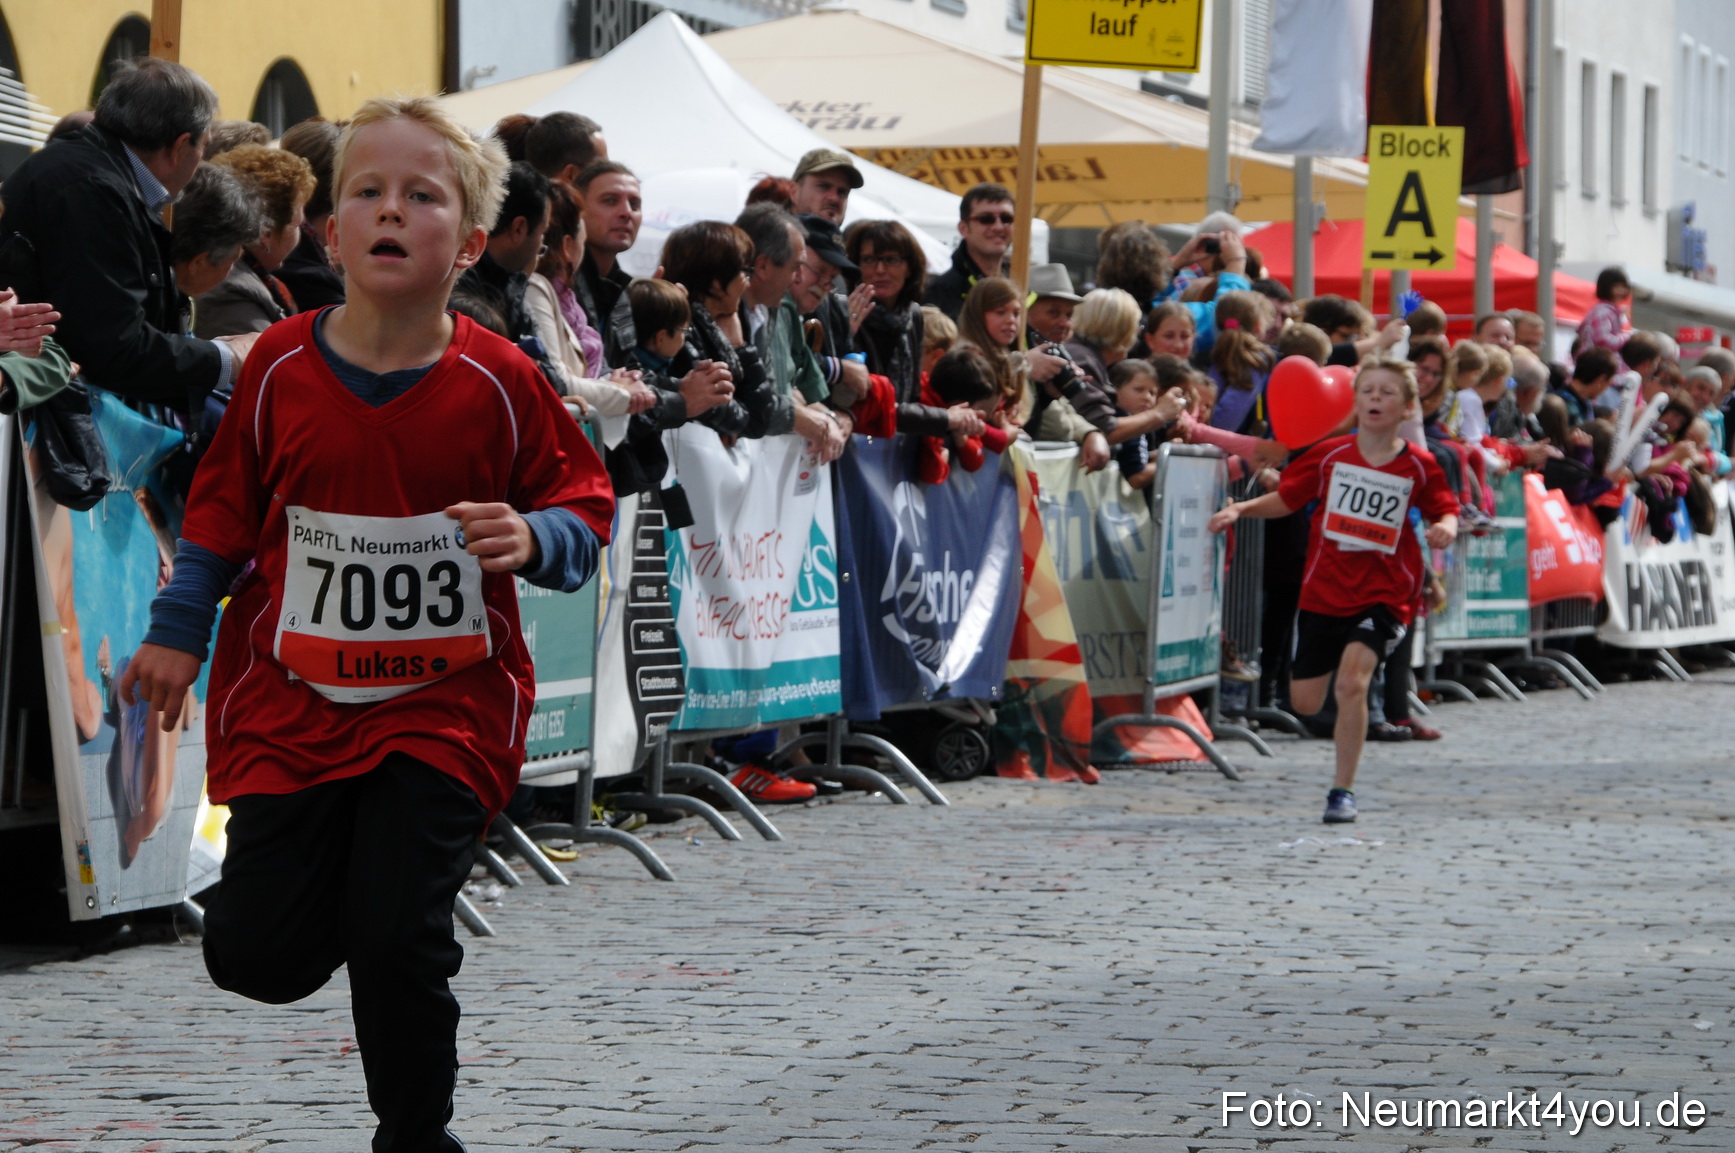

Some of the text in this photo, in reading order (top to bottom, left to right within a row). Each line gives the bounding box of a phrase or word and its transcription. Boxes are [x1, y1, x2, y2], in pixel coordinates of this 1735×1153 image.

[1090, 12, 1138, 36] lauf
[1380, 132, 1451, 157] Block
[1384, 170, 1435, 237] A
[1338, 482, 1399, 522] 7092
[293, 525, 449, 555] PARTL Neumarkt
[307, 557, 464, 631] 7093
[289, 616, 296, 627] 4
[473, 618, 481, 630] M
[337, 651, 425, 679] Lukas
